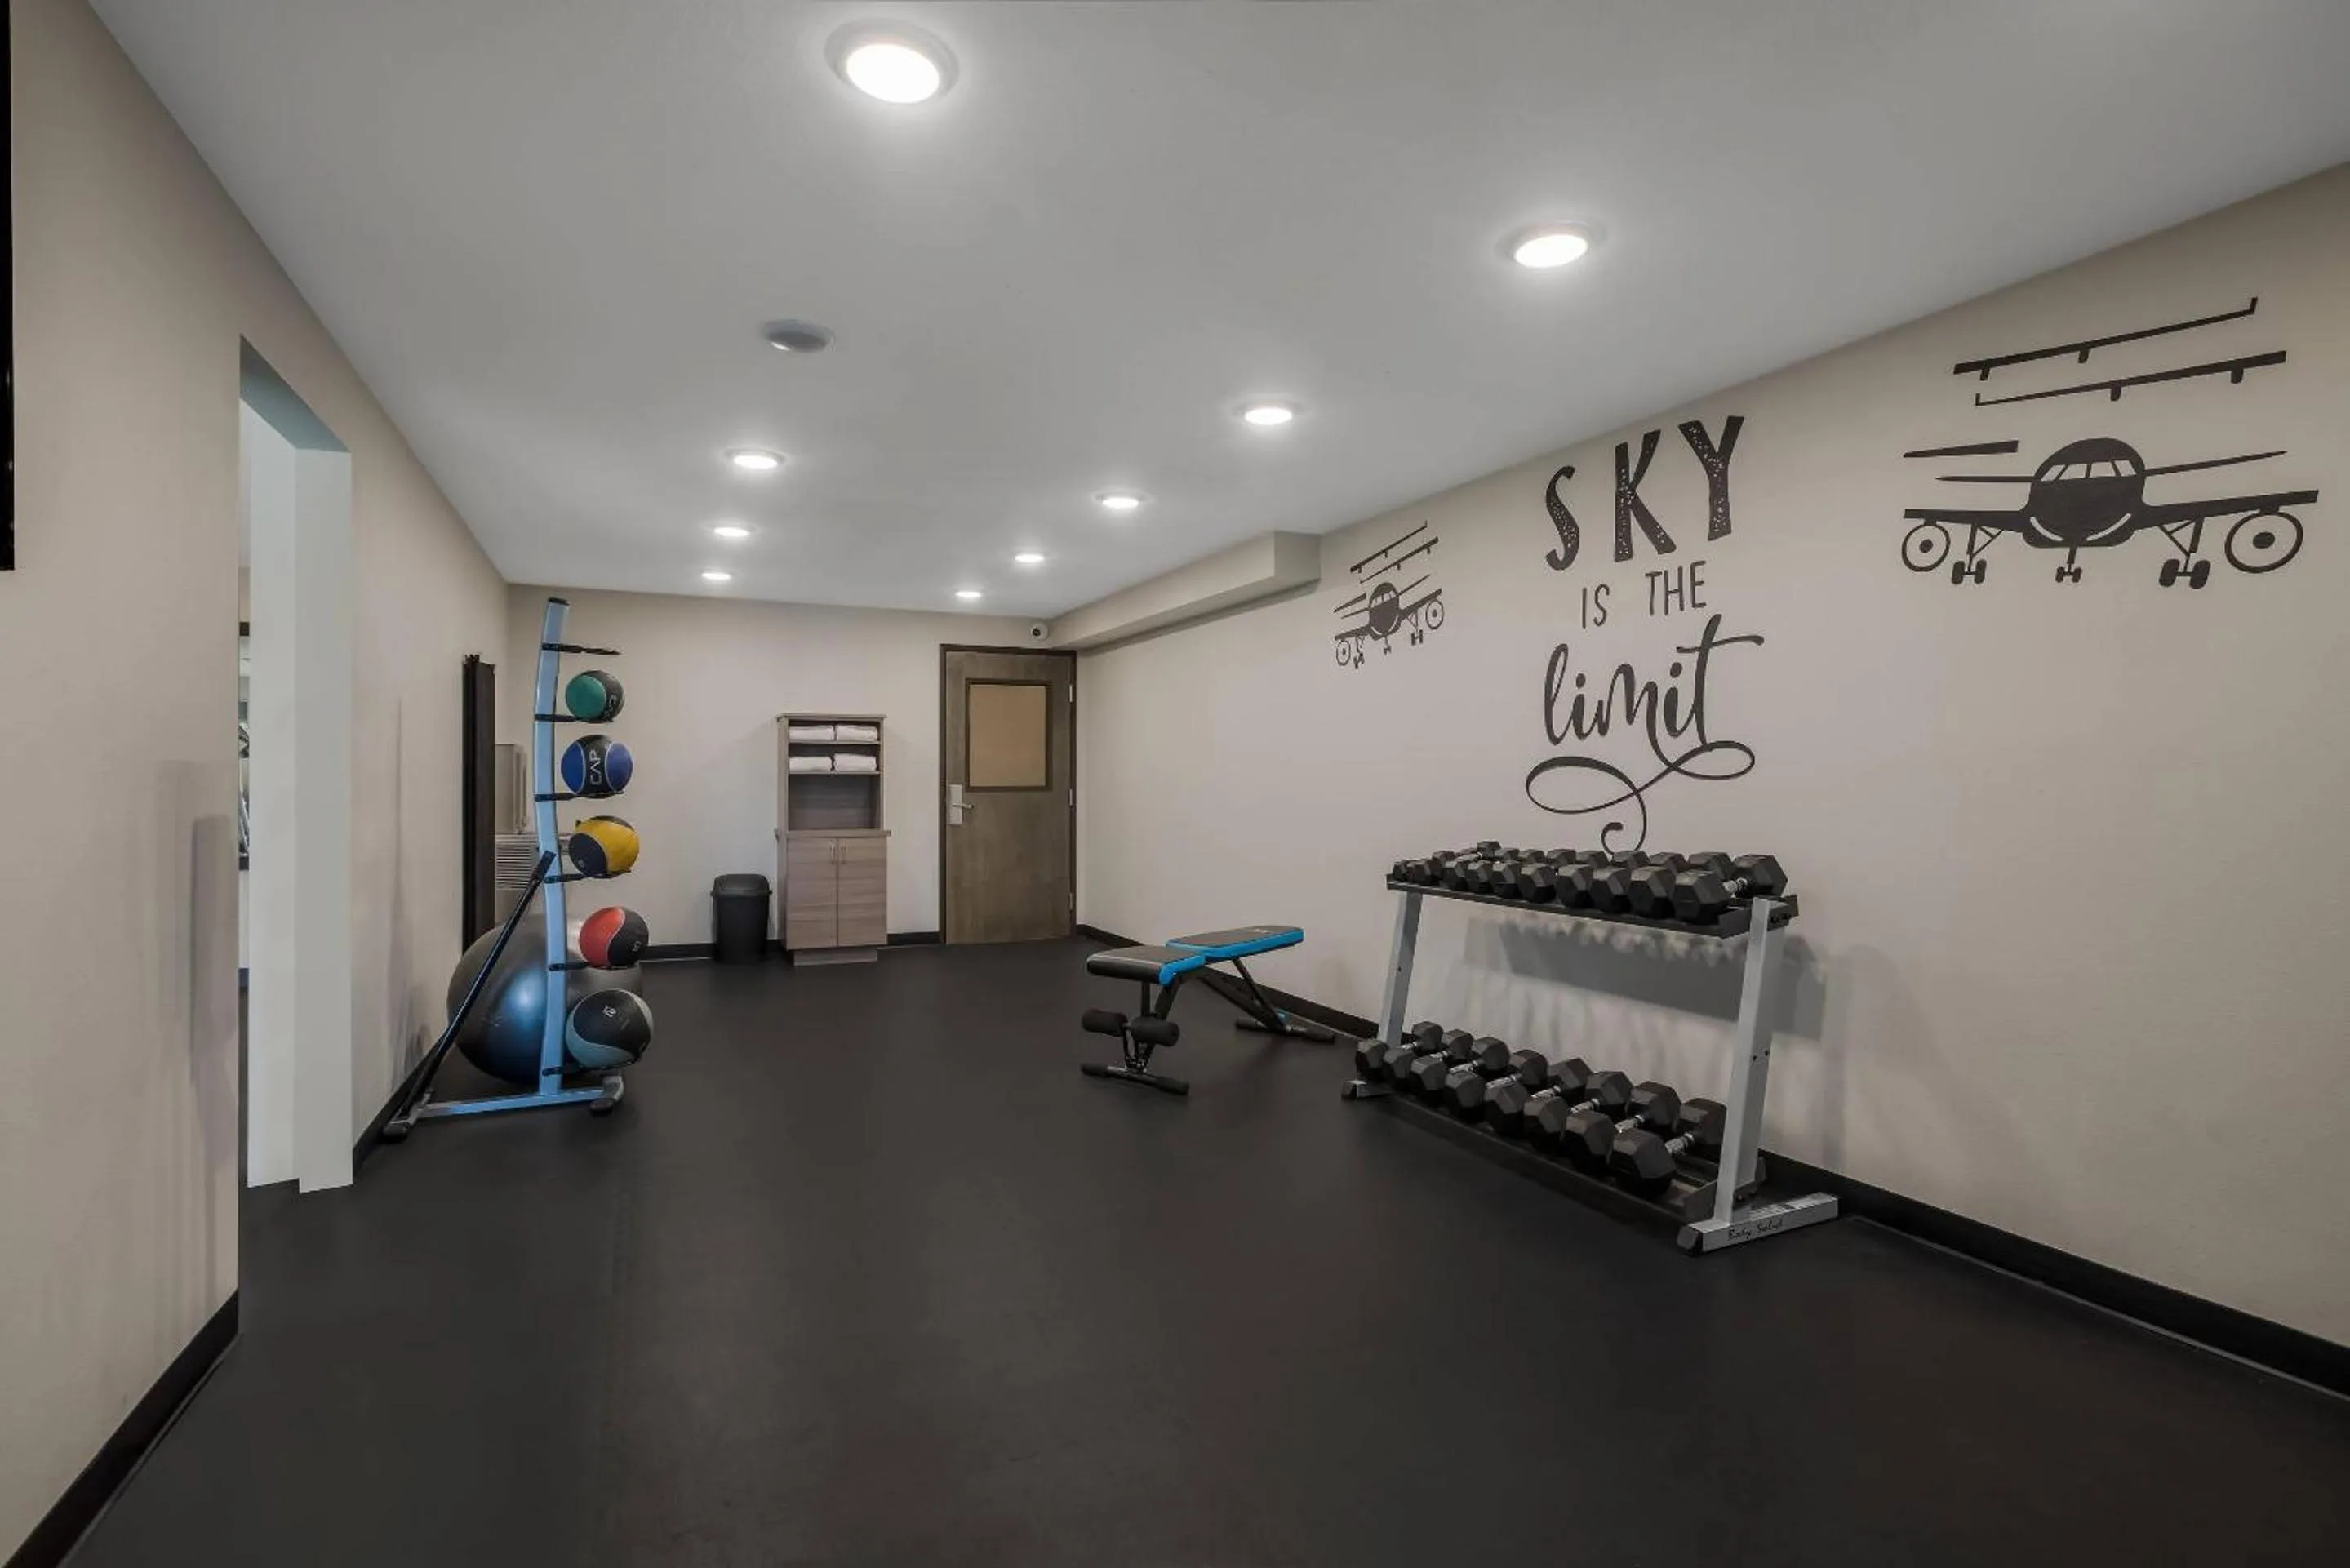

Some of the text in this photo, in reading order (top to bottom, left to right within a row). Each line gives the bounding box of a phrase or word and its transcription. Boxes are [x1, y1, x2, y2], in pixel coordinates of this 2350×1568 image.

[1544, 415, 1745, 571] SKY
[1581, 560, 1708, 629] IS THE
[1544, 613, 1765, 781] limit
[589, 748, 603, 786] CAP
